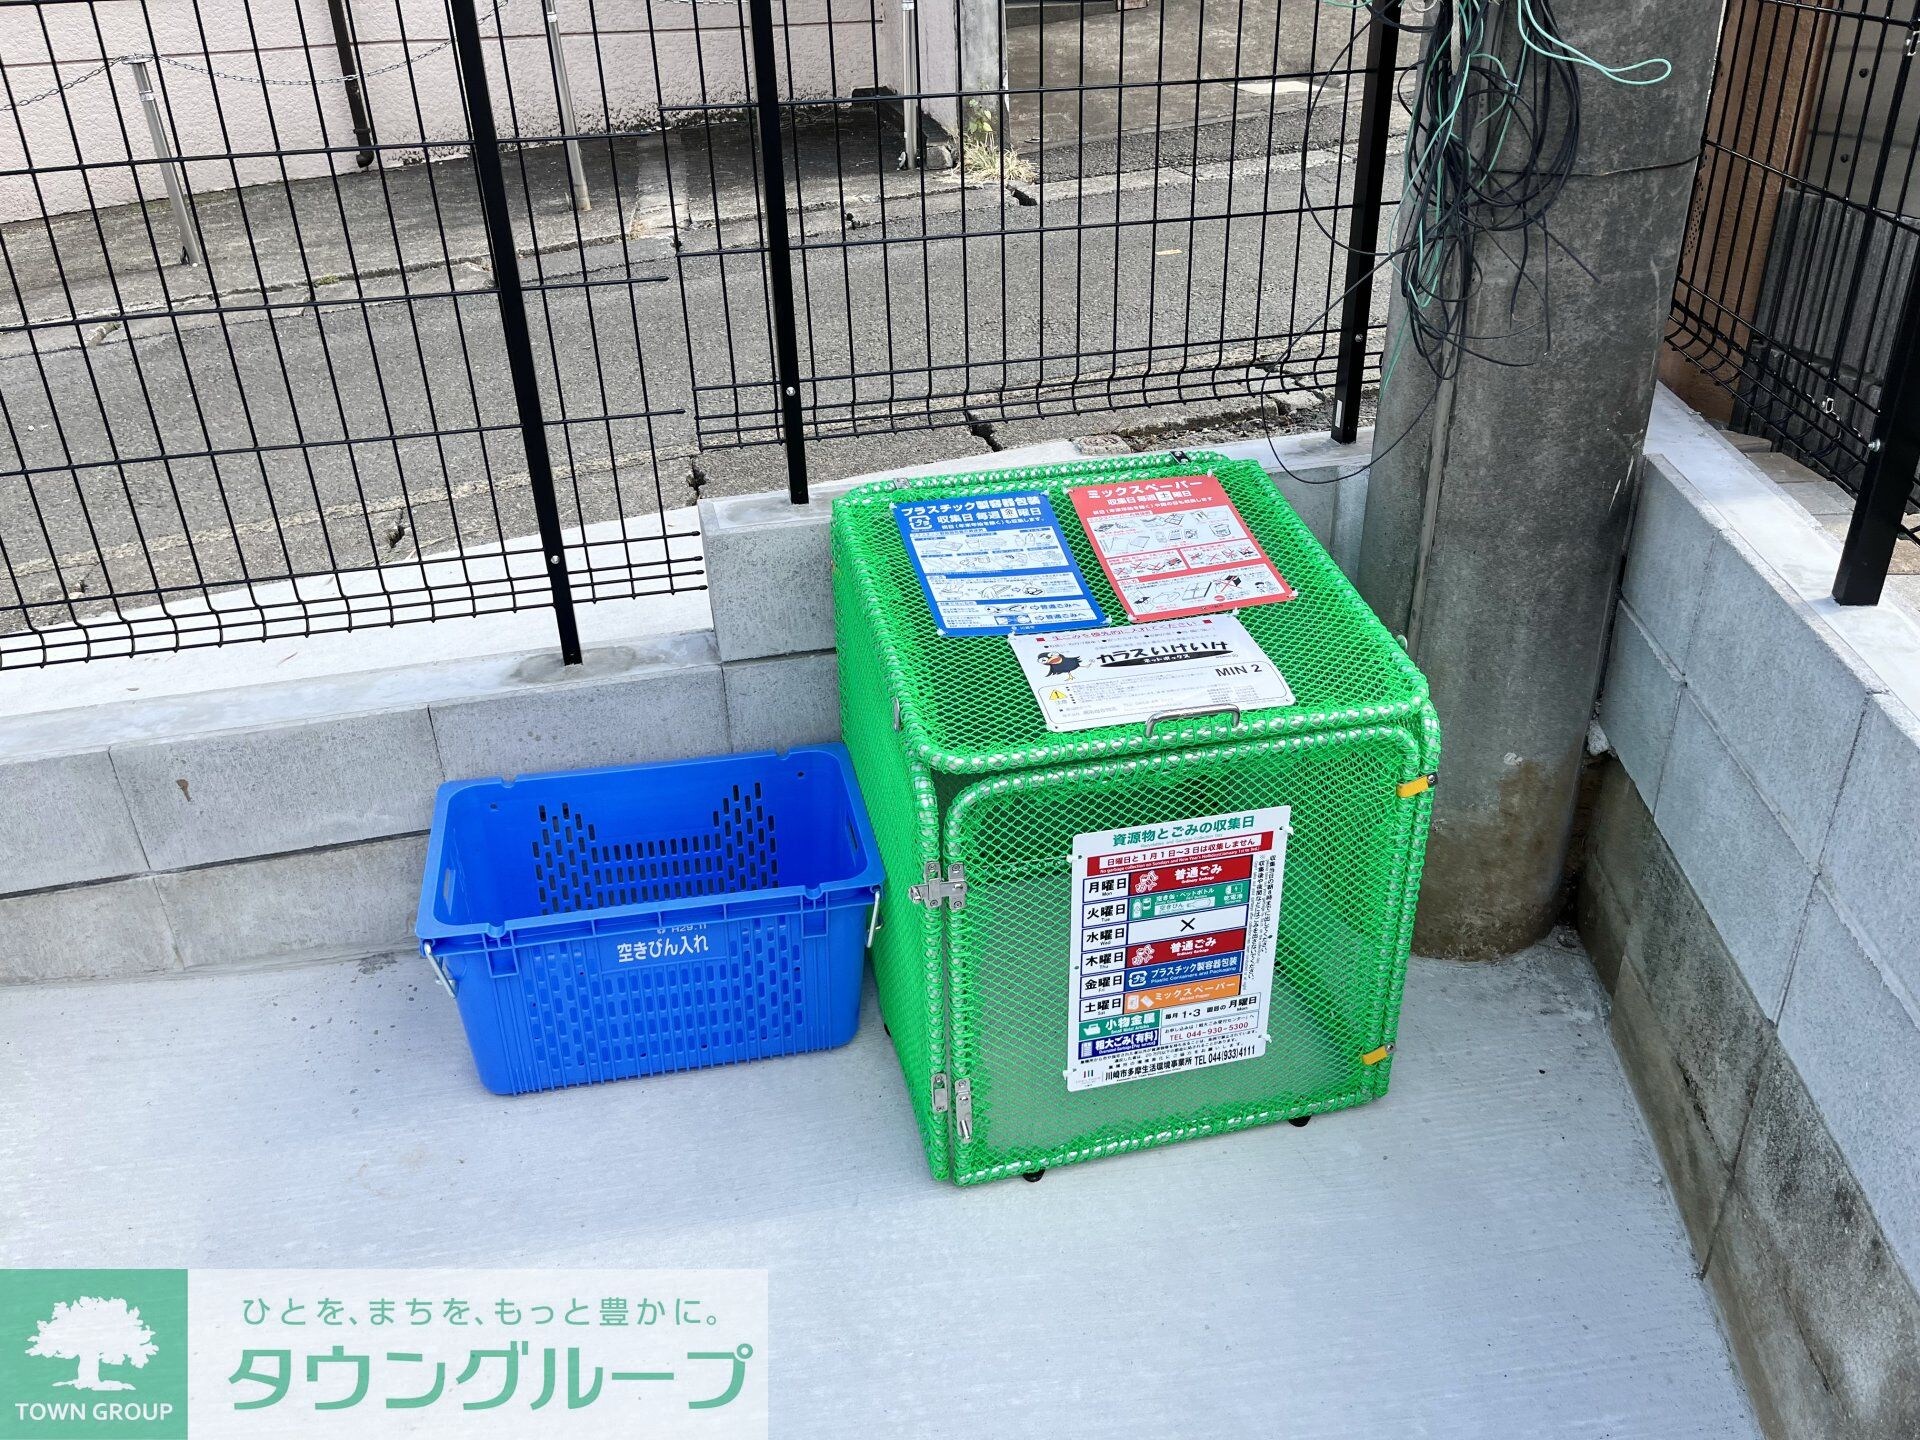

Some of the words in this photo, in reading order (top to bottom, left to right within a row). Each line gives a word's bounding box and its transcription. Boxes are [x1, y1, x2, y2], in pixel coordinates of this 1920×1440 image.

[1087, 481, 1203, 499] ミックスペーパー
[1215, 665, 1248, 677] MIN
[1251, 664, 1263, 673] 2
[1113, 815, 1255, 847] 資源物とごみの収集日
[1174, 862, 1222, 881] 普通ごみ
[1088, 877, 1126, 894] 月曜日
[1087, 903, 1125, 919] 火曜日
[1086, 927, 1124, 943] 水曜日
[617, 934, 709, 963] 空きびん入れ
[1170, 937, 1216, 954] 普通ごみ
[1086, 951, 1124, 967] 木曜日
[1151, 956, 1237, 979] プラスチック製容器包装
[1085, 975, 1122, 990] 金曜日
[1155, 982, 1236, 1000] ミックスペーパー
[1084, 998, 1122, 1013] 土曜日
[1228, 996, 1257, 1009] 月曜日
[1105, 1012, 1156, 1031] 小物金属
[1170, 1033, 1183, 1041] TEL
[1186, 1022, 1249, 1039] 044-930-5300
[1195, 1053, 1207, 1065] TEL
[1208, 1045, 1255, 1064] 044(933)4111
